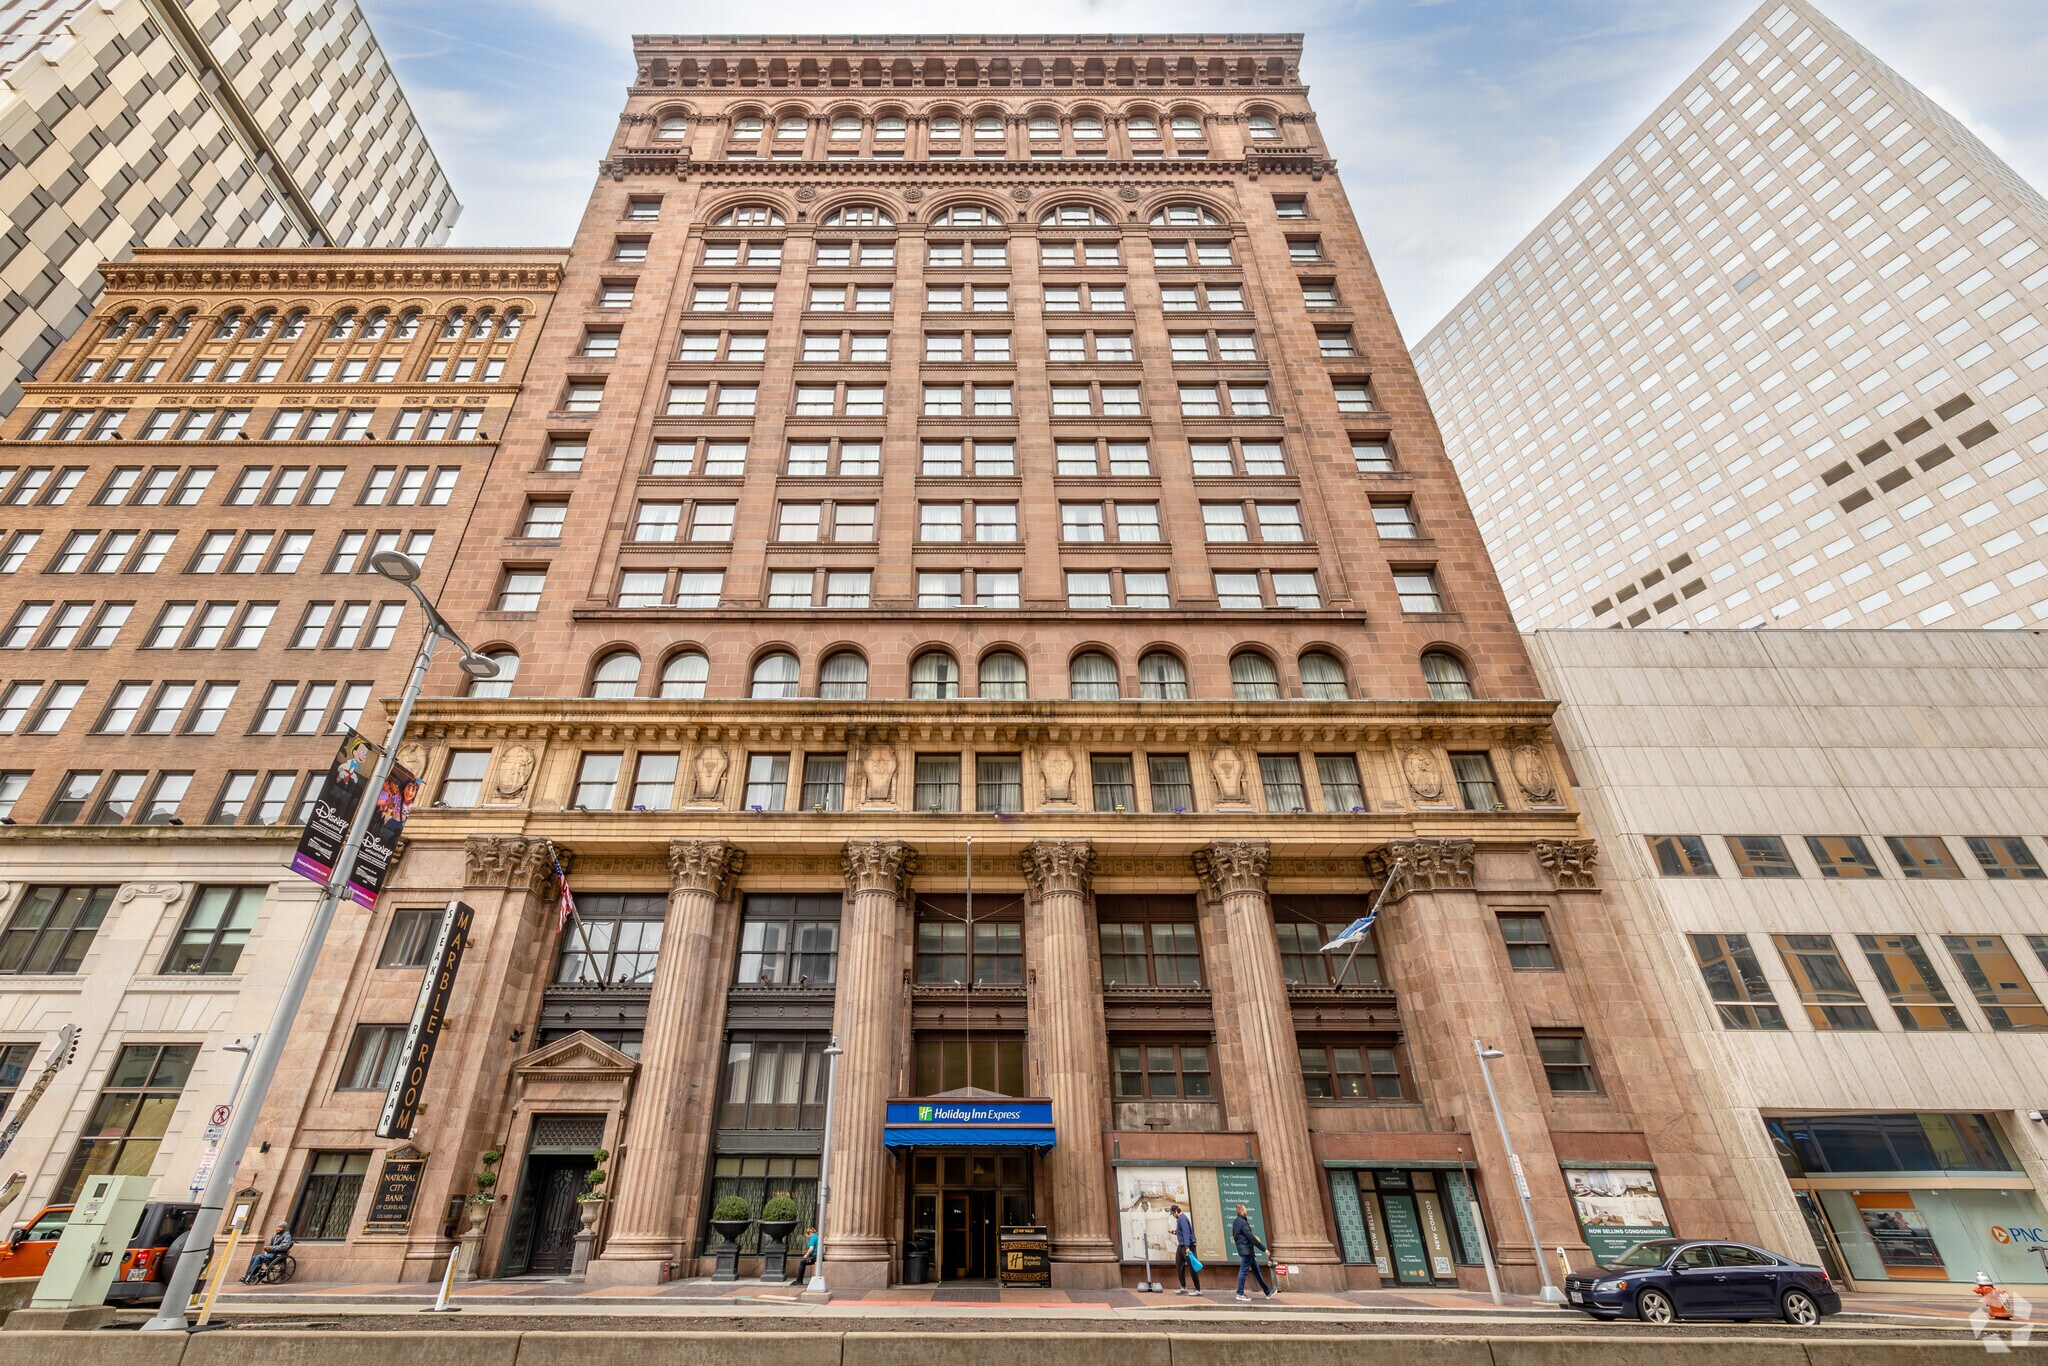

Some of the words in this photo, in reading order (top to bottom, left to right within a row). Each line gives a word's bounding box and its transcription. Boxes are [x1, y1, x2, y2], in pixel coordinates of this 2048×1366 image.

[316, 800, 349, 834] Disney
[319, 819, 340, 832] ANIMATION
[362, 831, 393, 862] Disney
[365, 848, 385, 860] ANIMATION
[426, 909, 453, 990] STEAKS
[427, 911, 469, 1034] MARBLE
[402, 1024, 418, 1066] RAW
[396, 1044, 429, 1130] ROOM
[383, 1081, 400, 1126] BAR
[934, 1108, 971, 1122] Holiday
[972, 1108, 986, 1119] Inn
[988, 1109, 1020, 1121] Express
[389, 1184, 407, 1192] CITY
[1365, 1201, 1375, 1231] SELLING
[1425, 1200, 1437, 1231] CONDOS
[1371, 1233, 1379, 1250] NOW
[1433, 1233, 1441, 1250] NEW
[2007, 1227, 2048, 1243] PNC
